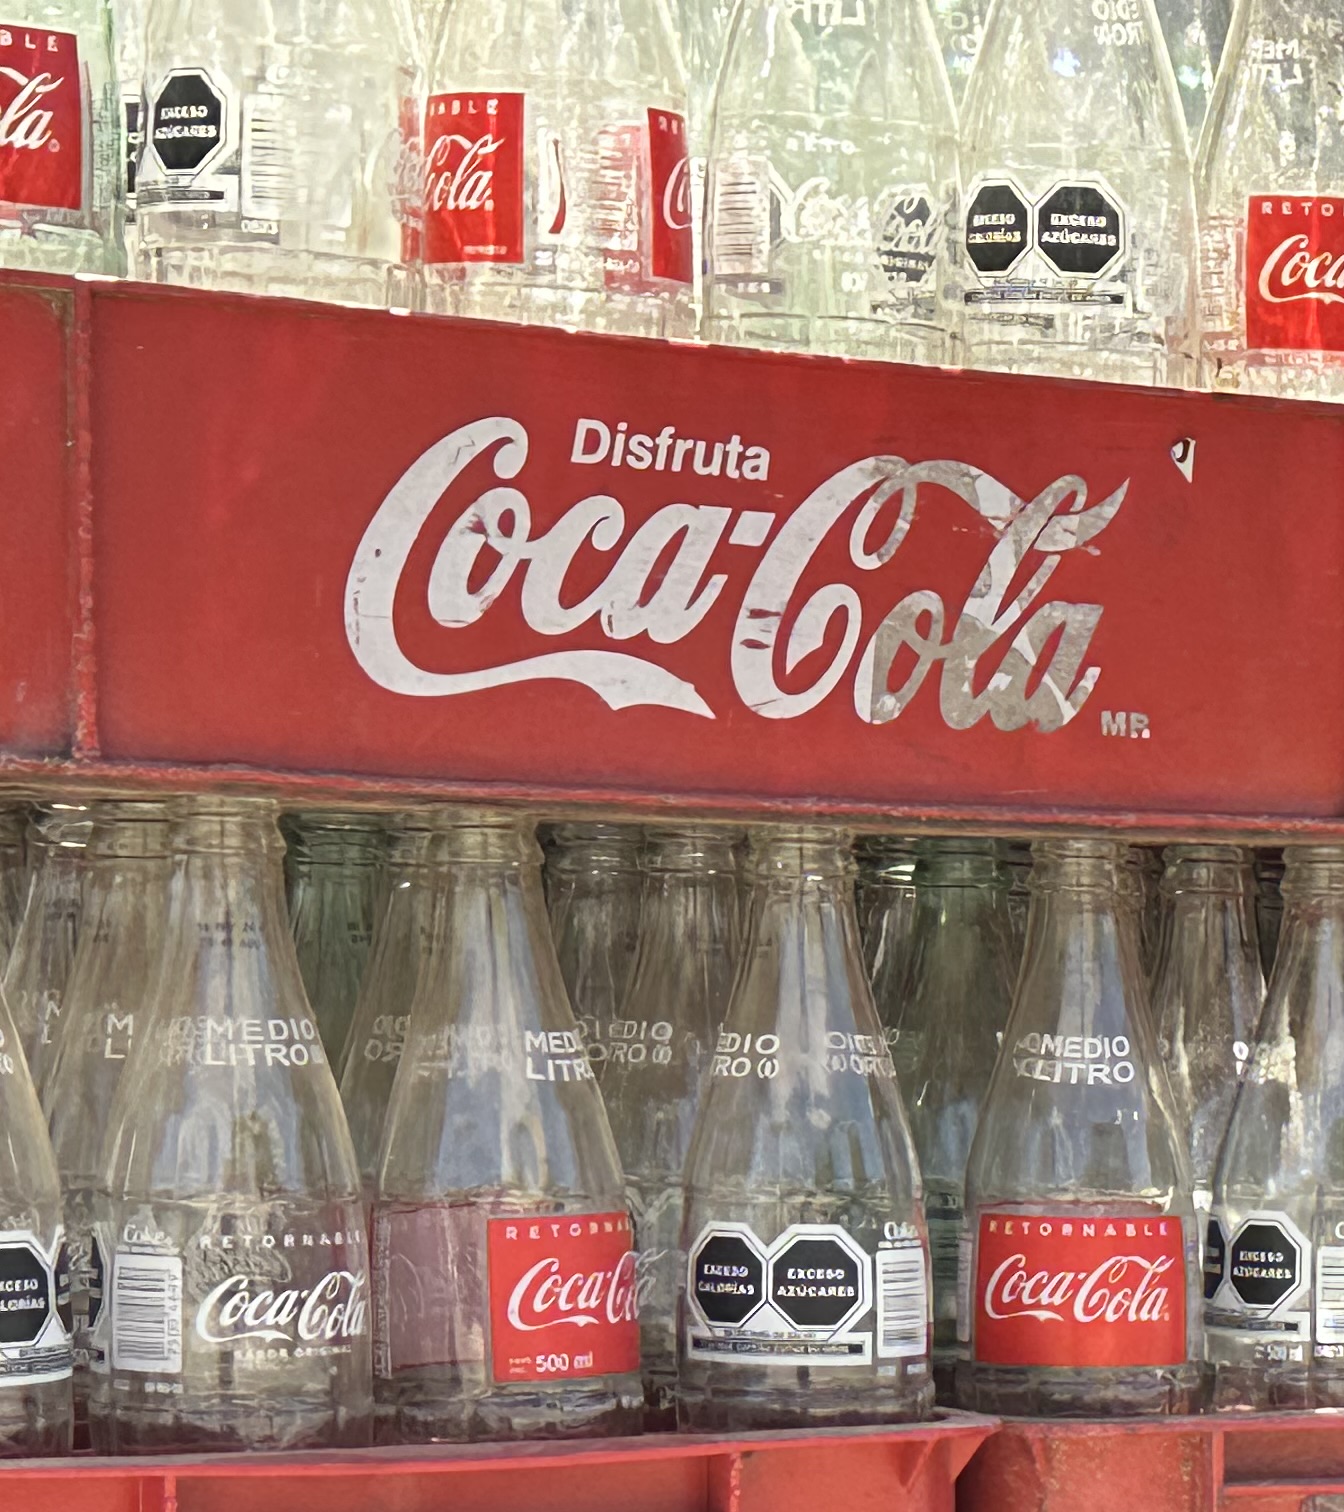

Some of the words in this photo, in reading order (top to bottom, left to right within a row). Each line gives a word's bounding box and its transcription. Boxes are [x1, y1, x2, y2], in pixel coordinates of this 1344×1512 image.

[570, 417, 772, 483] Disfruta
[343, 415, 1132, 735] Coca-Cola
[1099, 710, 1152, 741] MR
[1041, 1033, 1131, 1060] MEDIO
[987, 1220, 1170, 1239] RETORNABLE
[984, 1251, 1175, 1326] Coca-Cola
[534, 1352, 571, 1373] 500
